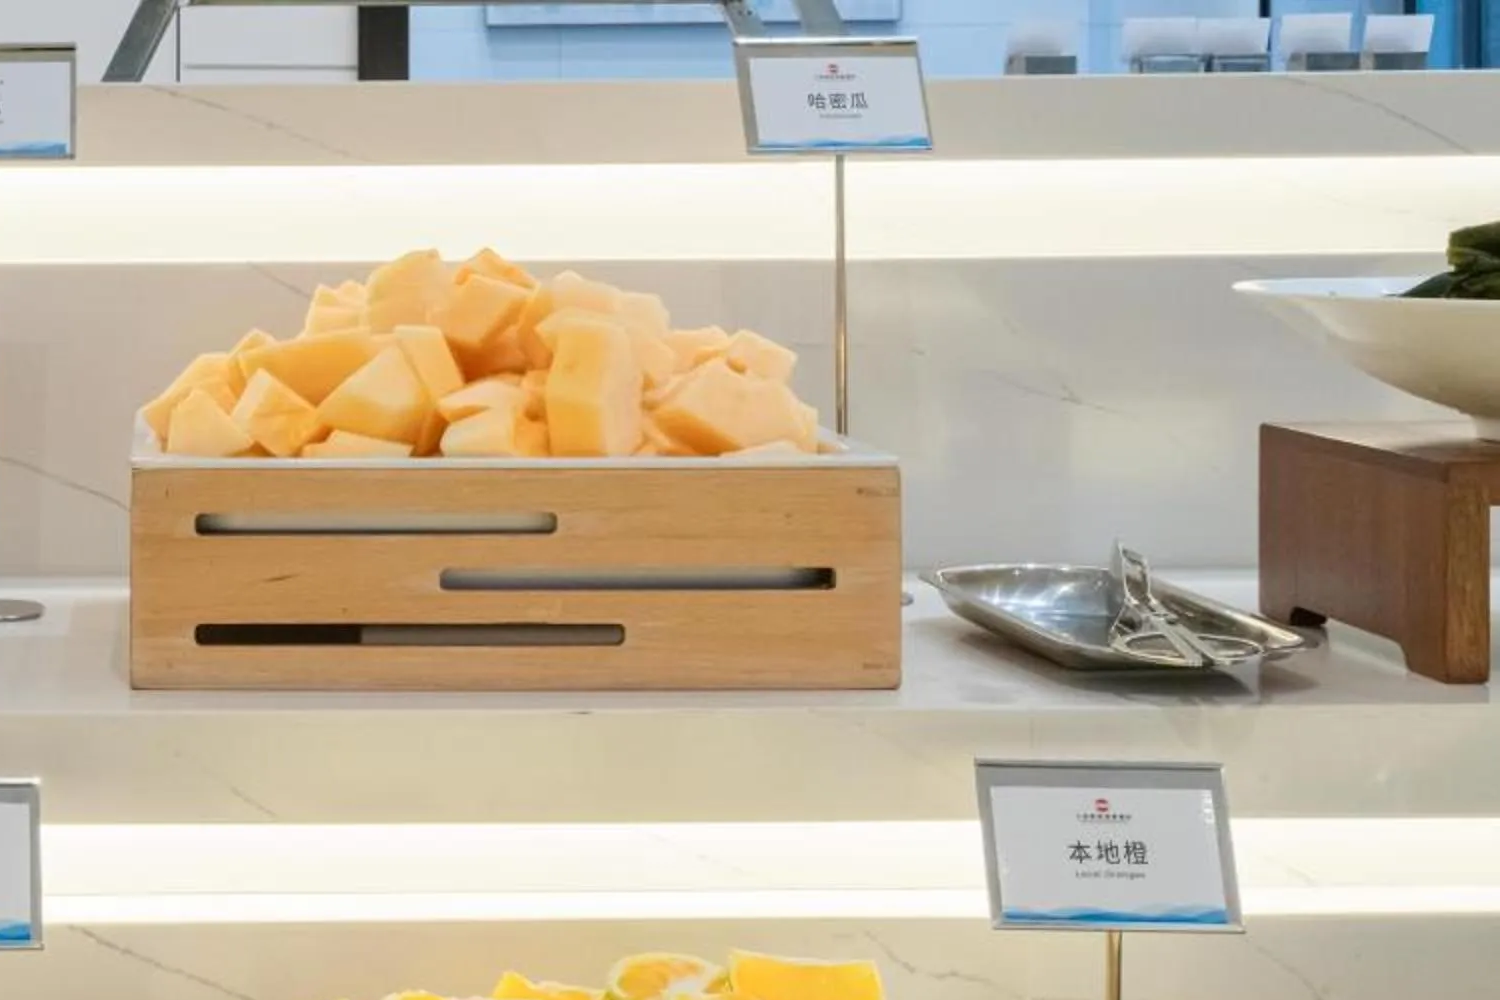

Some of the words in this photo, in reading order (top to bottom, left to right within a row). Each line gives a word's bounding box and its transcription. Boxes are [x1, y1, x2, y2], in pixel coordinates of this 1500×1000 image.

[807, 92, 869, 110] 哈密瓜
[1068, 840, 1149, 866] 本地橙
